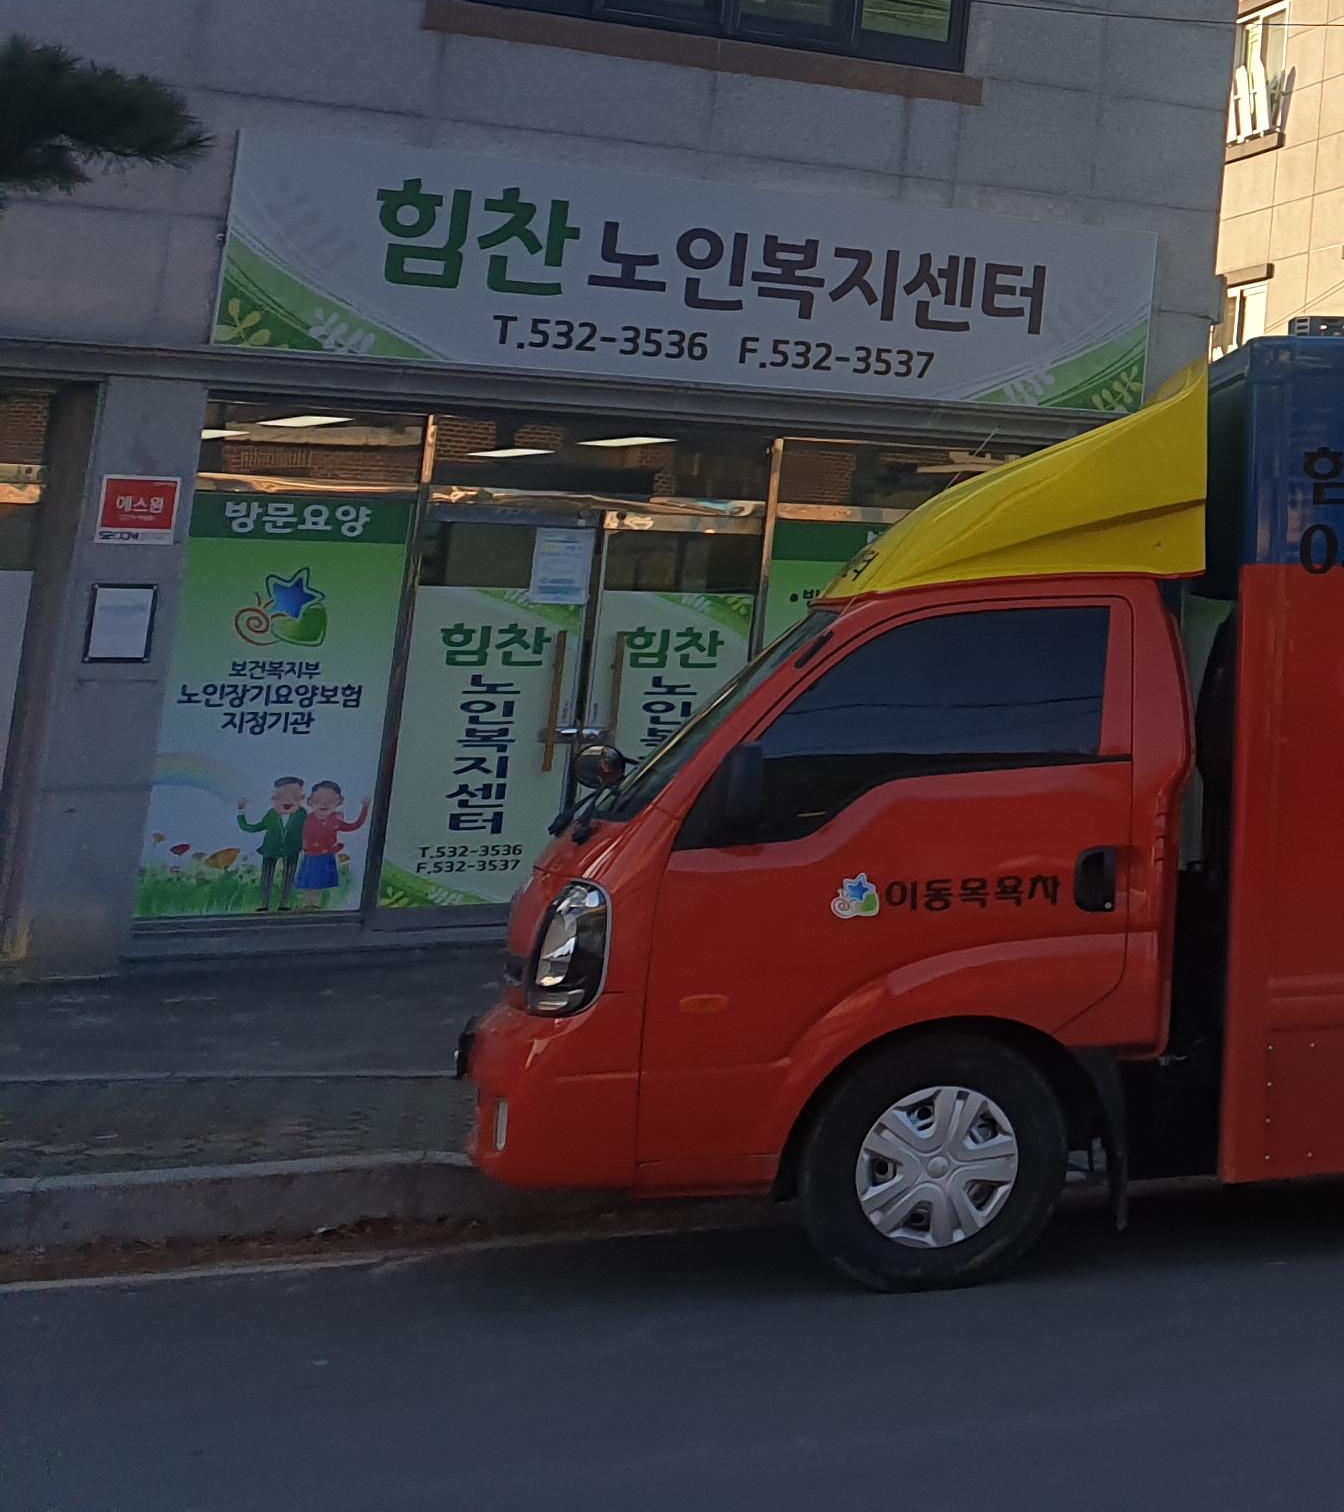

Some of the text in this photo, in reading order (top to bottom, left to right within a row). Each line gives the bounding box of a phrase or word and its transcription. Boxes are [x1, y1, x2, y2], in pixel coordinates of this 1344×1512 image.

[376, 178, 1047, 335] 힘찬 노인복지센터
[493, 314, 934, 379] T.532-3536 F.532-3537
[225, 501, 372, 537] 방문요양
[440, 623, 552, 667] 힘찬
[624, 626, 725, 669] 힘찬
[228, 660, 321, 680] 보건복지부
[176, 683, 363, 708] 노인장기요양보험
[221, 711, 315, 735] 지정기관
[446, 674, 521, 834] 노인복지센터
[416, 859, 520, 874] F.532-3537
[419, 844, 523, 859] T.532-3536
[886, 874, 1061, 911] 이동목욕차
